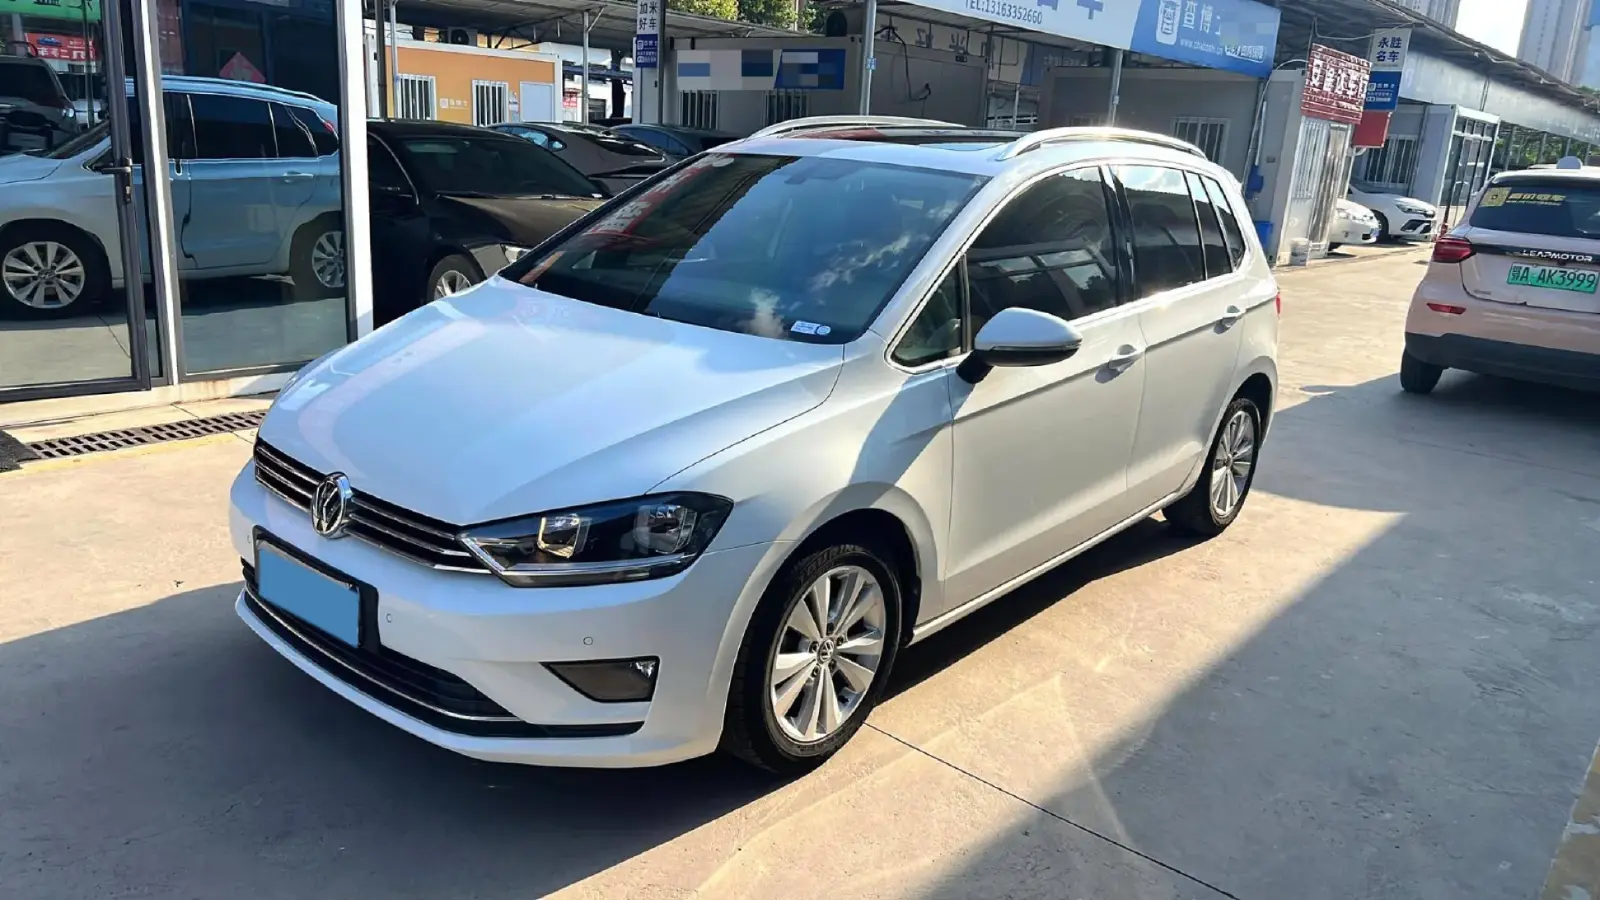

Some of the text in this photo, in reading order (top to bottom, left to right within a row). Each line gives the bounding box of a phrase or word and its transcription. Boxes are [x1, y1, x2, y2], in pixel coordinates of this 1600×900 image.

[639, 2, 657, 14] 加米
[639, 17, 657, 30] 好车
[1378, 36, 1402, 49] 永胜
[1376, 50, 1400, 63] 名车
[1522, 249, 1593, 262] LEAPMOTOR
[1537, 268, 1596, 289] AK3999
